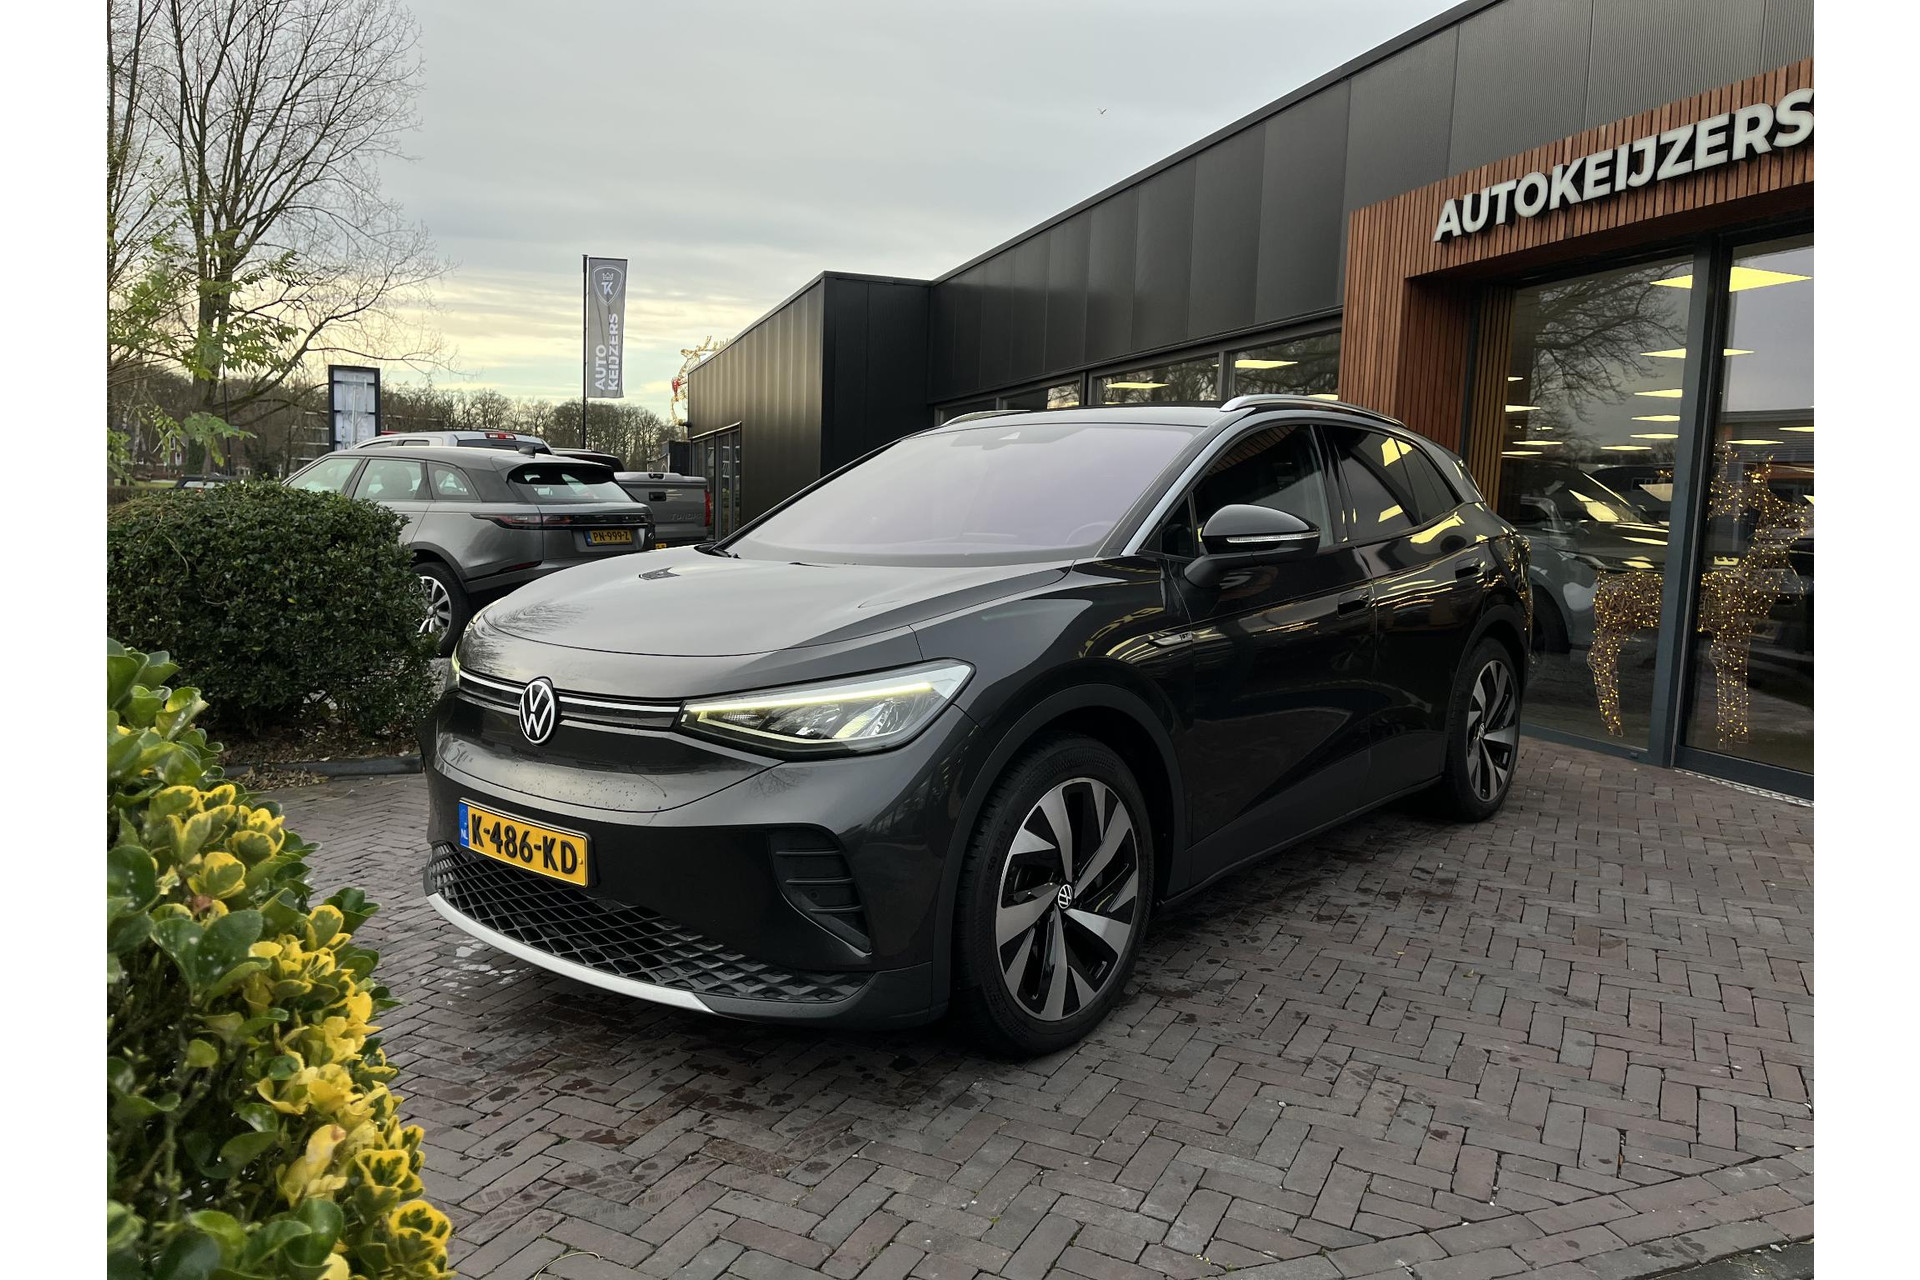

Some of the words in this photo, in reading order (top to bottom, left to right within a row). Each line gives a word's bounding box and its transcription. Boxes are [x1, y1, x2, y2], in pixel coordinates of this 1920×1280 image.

[1432, 87, 1814, 242] AUTOKEIJZERS
[594, 344, 607, 390] AUTO
[608, 313, 619, 391] KEIJZERS
[592, 531, 629, 542] PN-999-Z
[471, 813, 578, 875] K-486-KD
